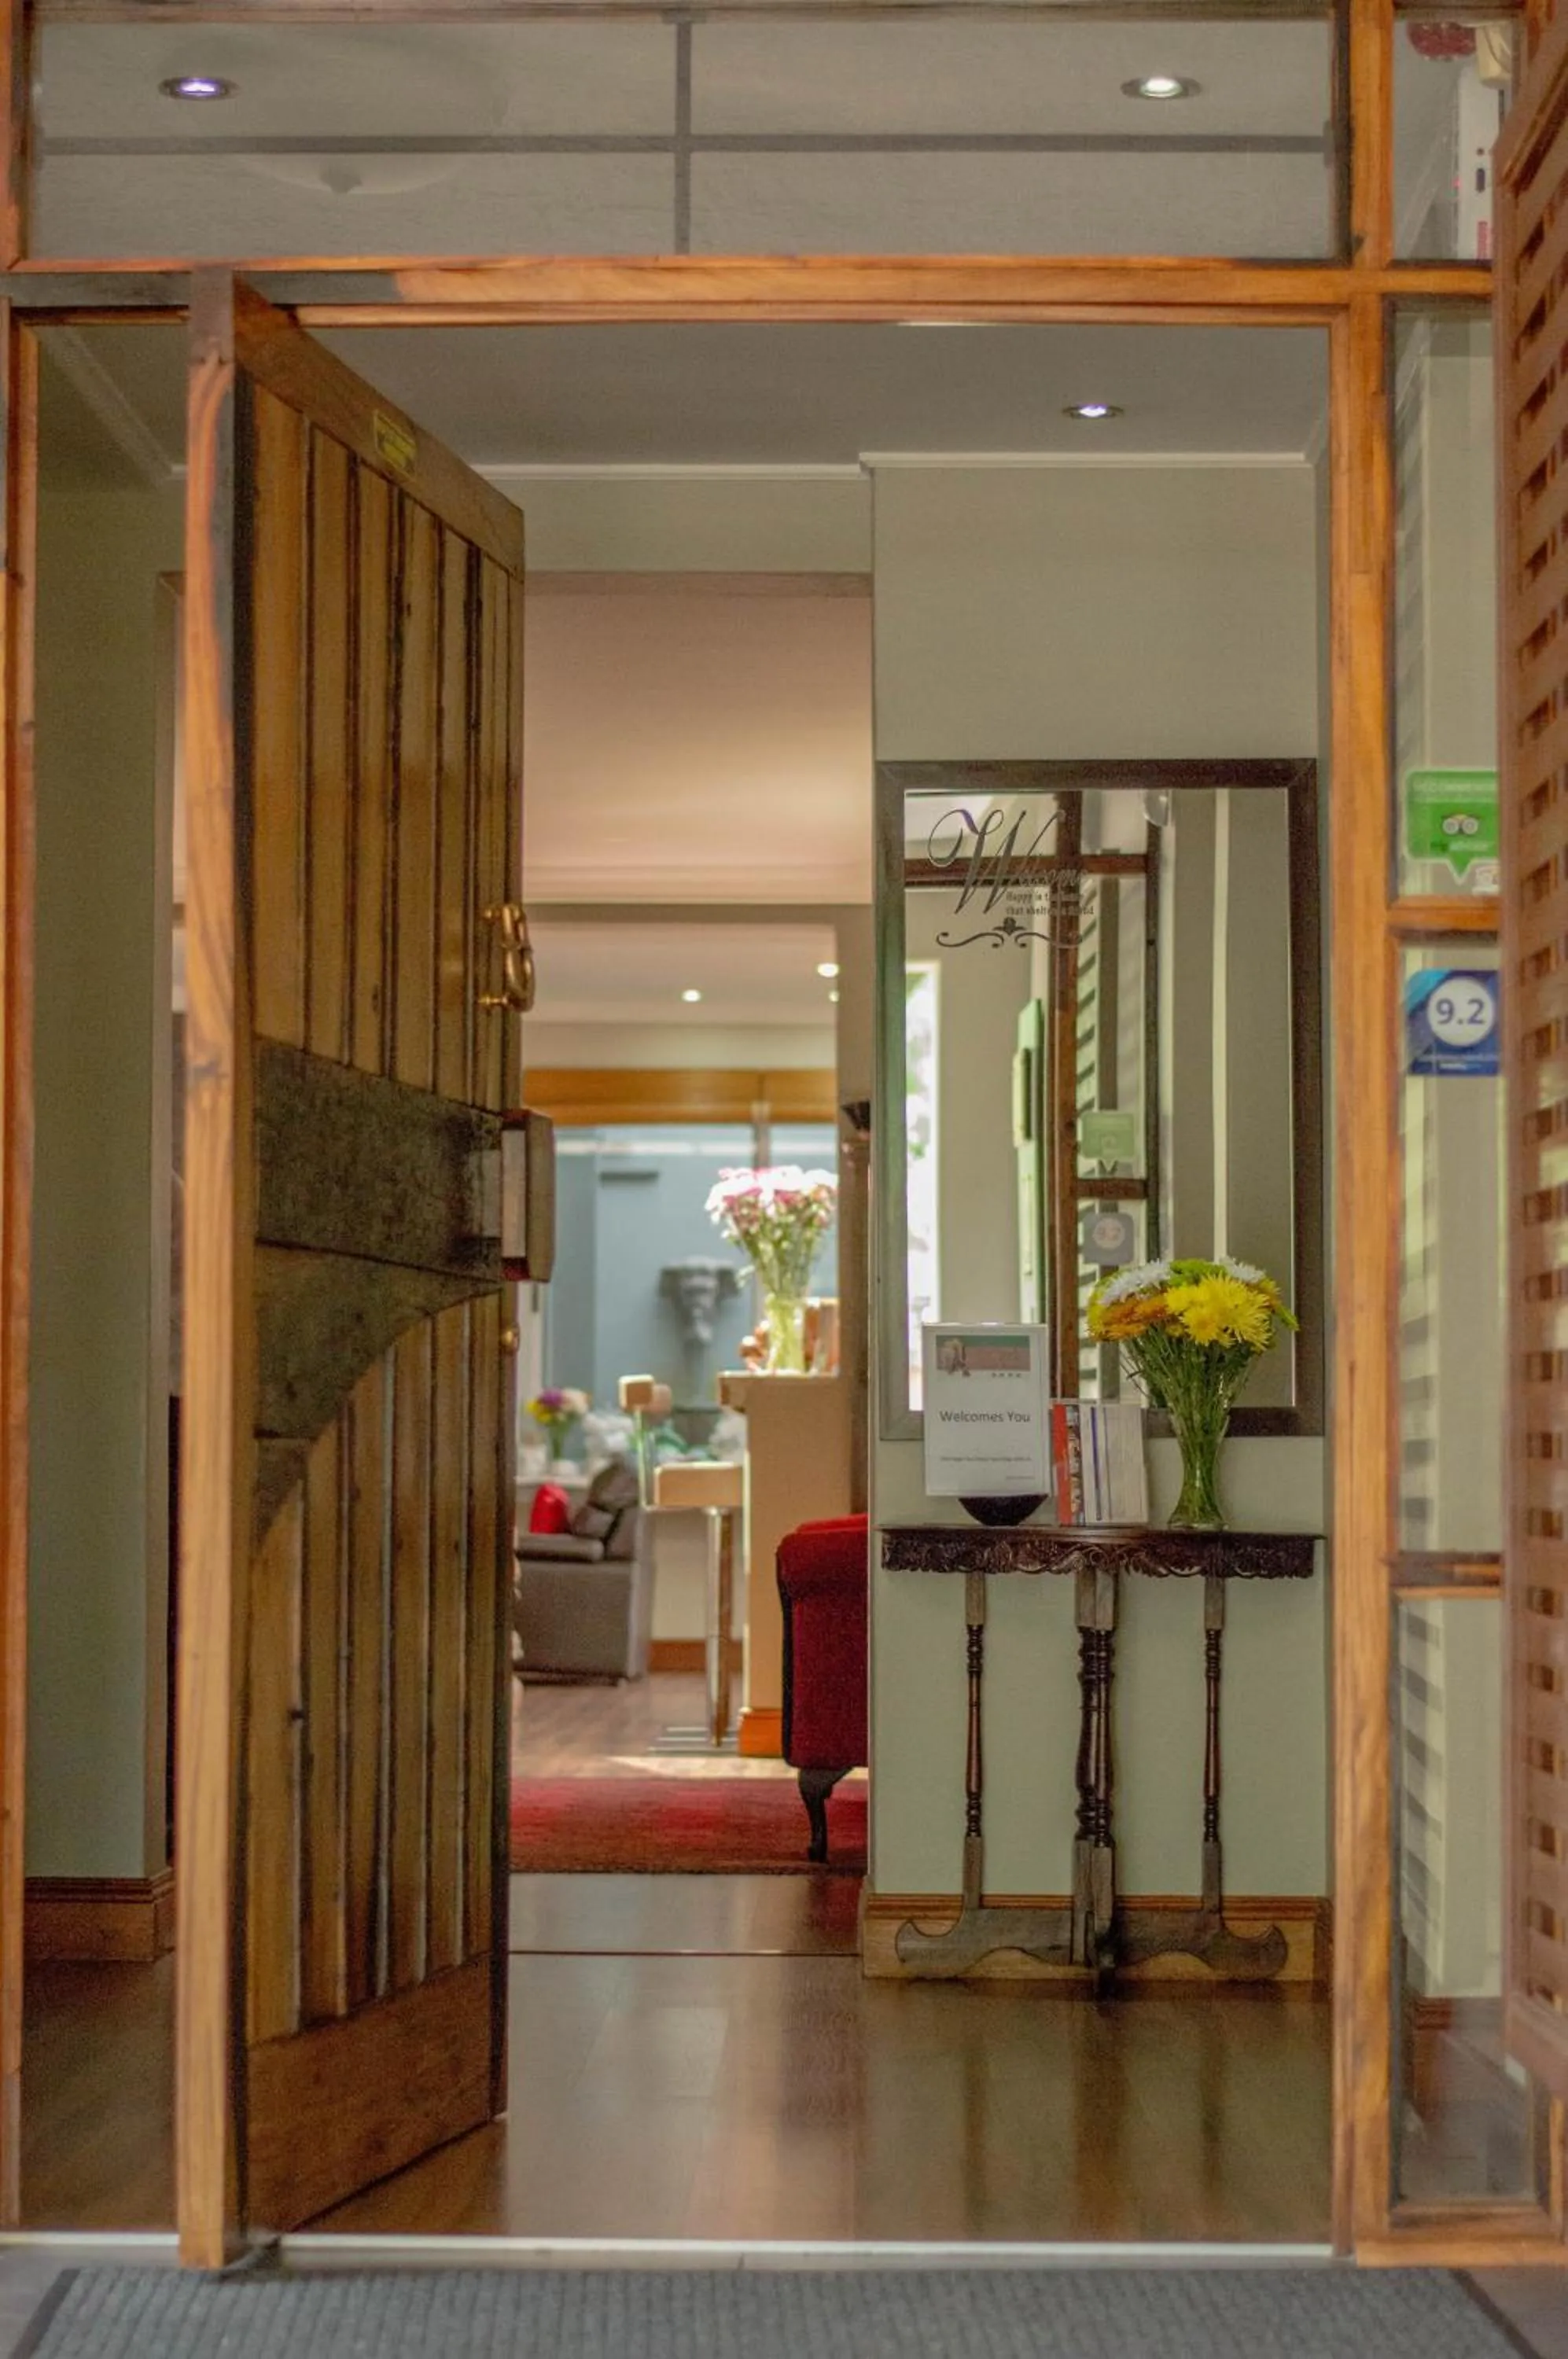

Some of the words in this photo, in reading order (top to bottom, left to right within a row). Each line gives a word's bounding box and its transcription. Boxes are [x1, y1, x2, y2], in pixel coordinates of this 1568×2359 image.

[1436, 998, 1485, 1025] 9.2
[940, 1411, 1003, 1423] Welcomes
[1007, 1411, 1031, 1423] You
